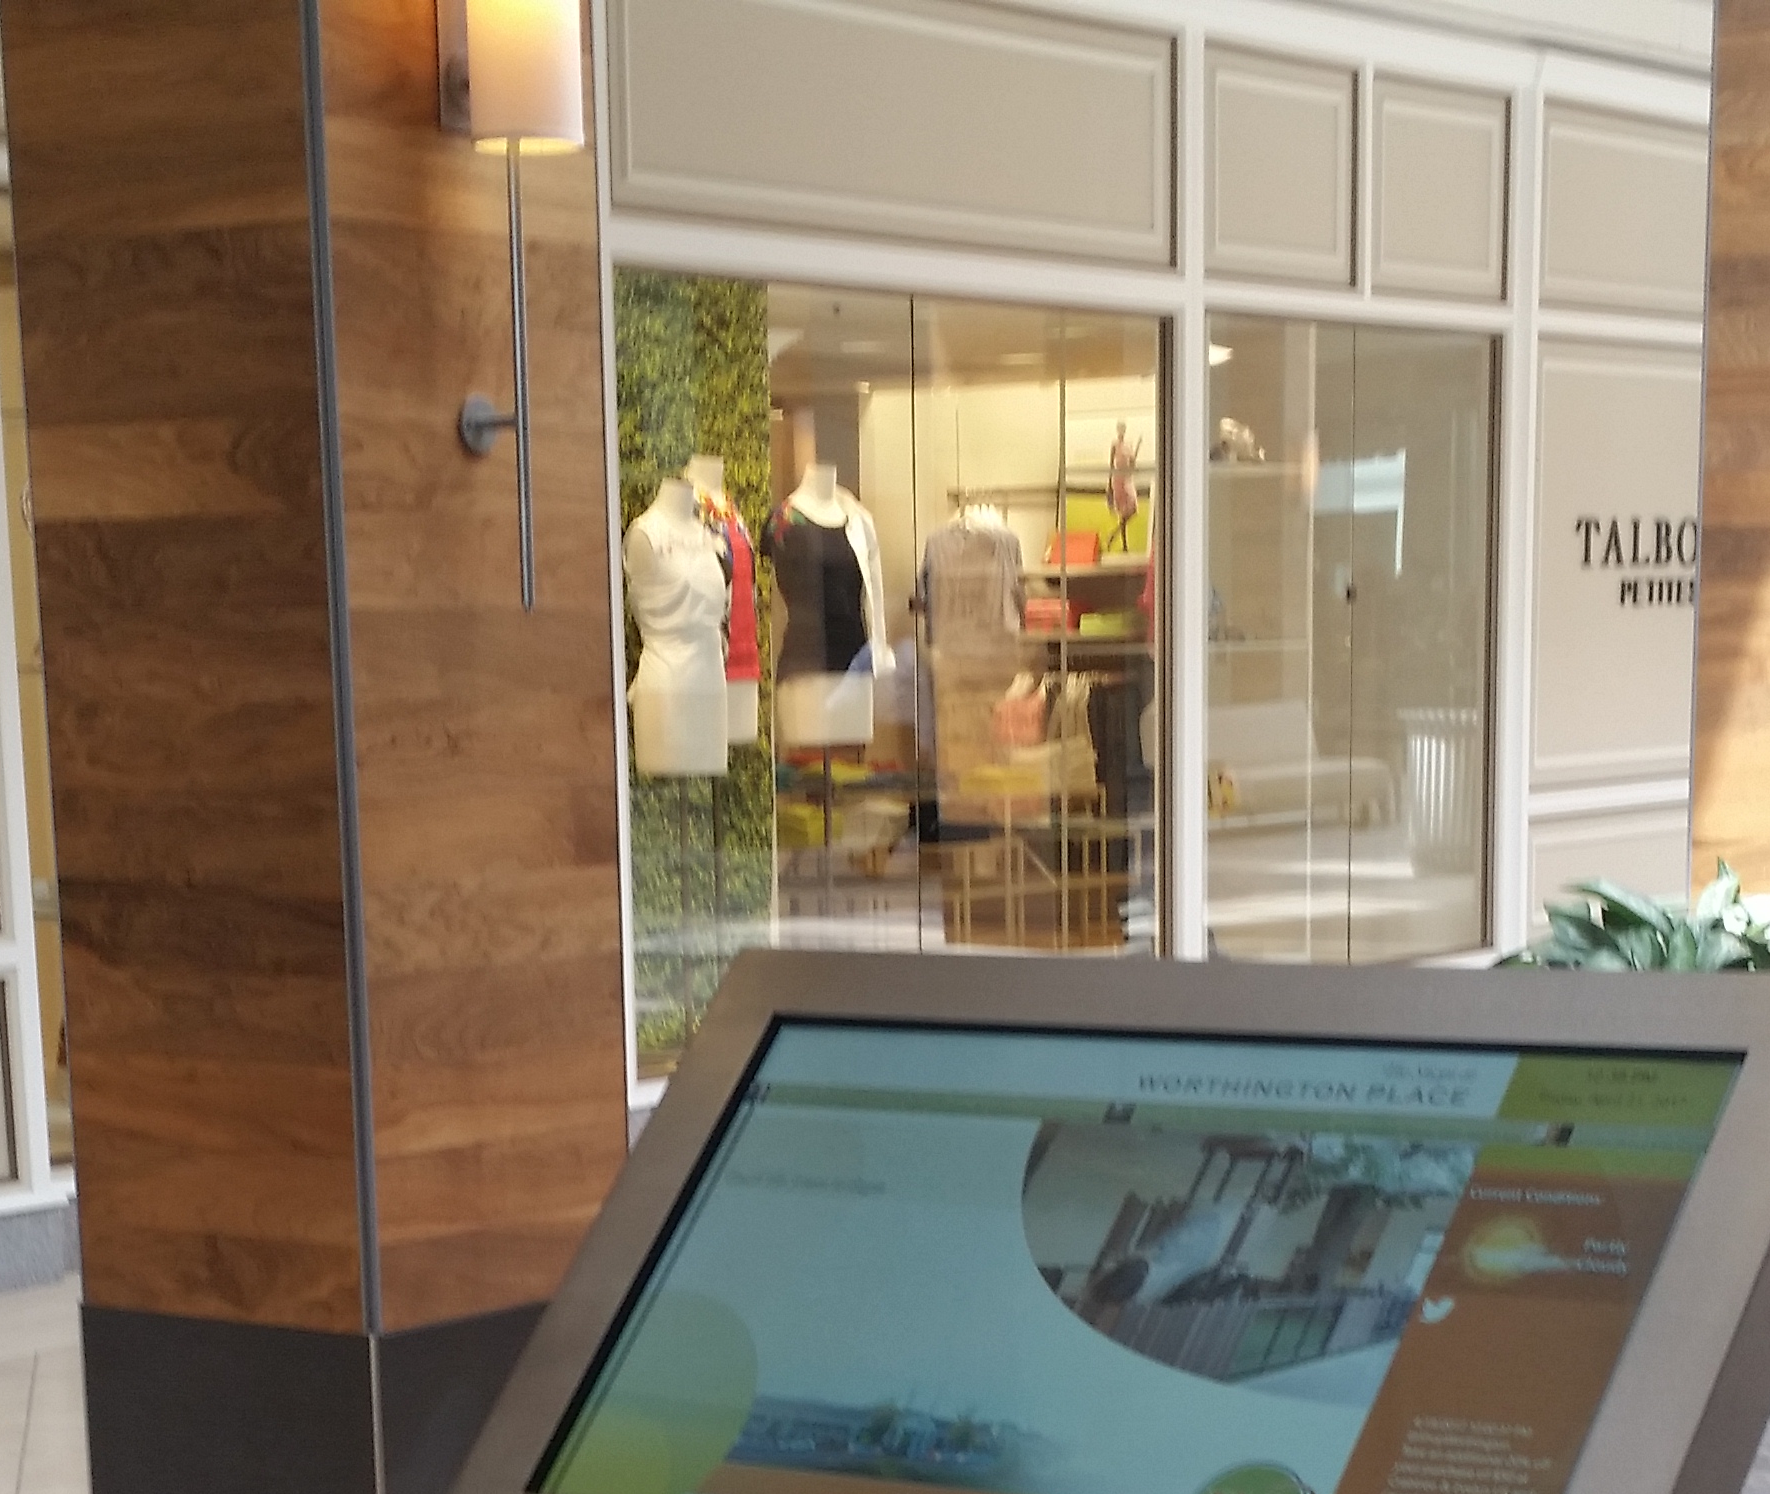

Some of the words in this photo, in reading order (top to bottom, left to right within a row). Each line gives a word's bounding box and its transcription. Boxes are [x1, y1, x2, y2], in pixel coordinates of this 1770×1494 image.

[1575, 514, 1697, 568] TALBO
[1137, 1072, 1358, 1102] WORTHINGTON
[1365, 1082, 1470, 1108] PLACE
